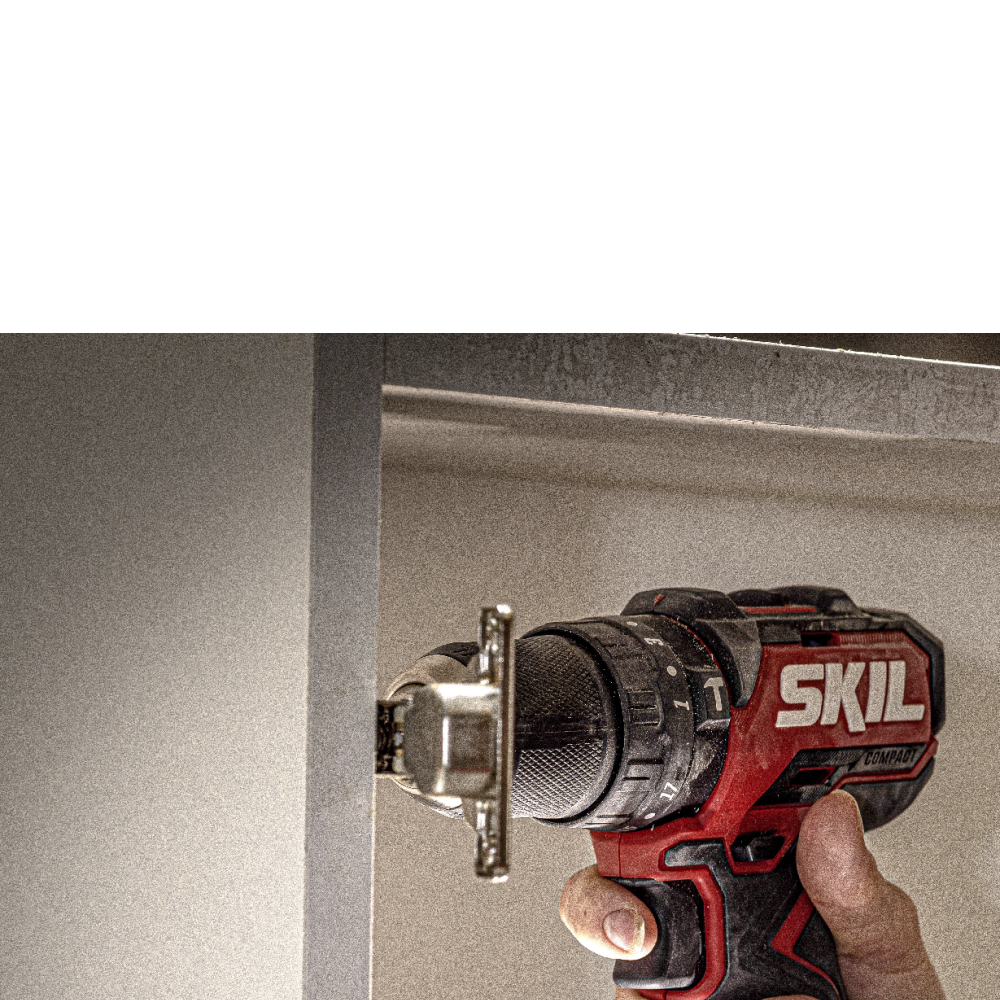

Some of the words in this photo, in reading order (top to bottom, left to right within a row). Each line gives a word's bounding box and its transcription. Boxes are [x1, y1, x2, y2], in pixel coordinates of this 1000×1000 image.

[673, 700, 690, 711] 1
[776, 660, 925, 733] SKIL
[864, 749, 918, 766] COMPACT
[660, 781, 677, 801] 17
